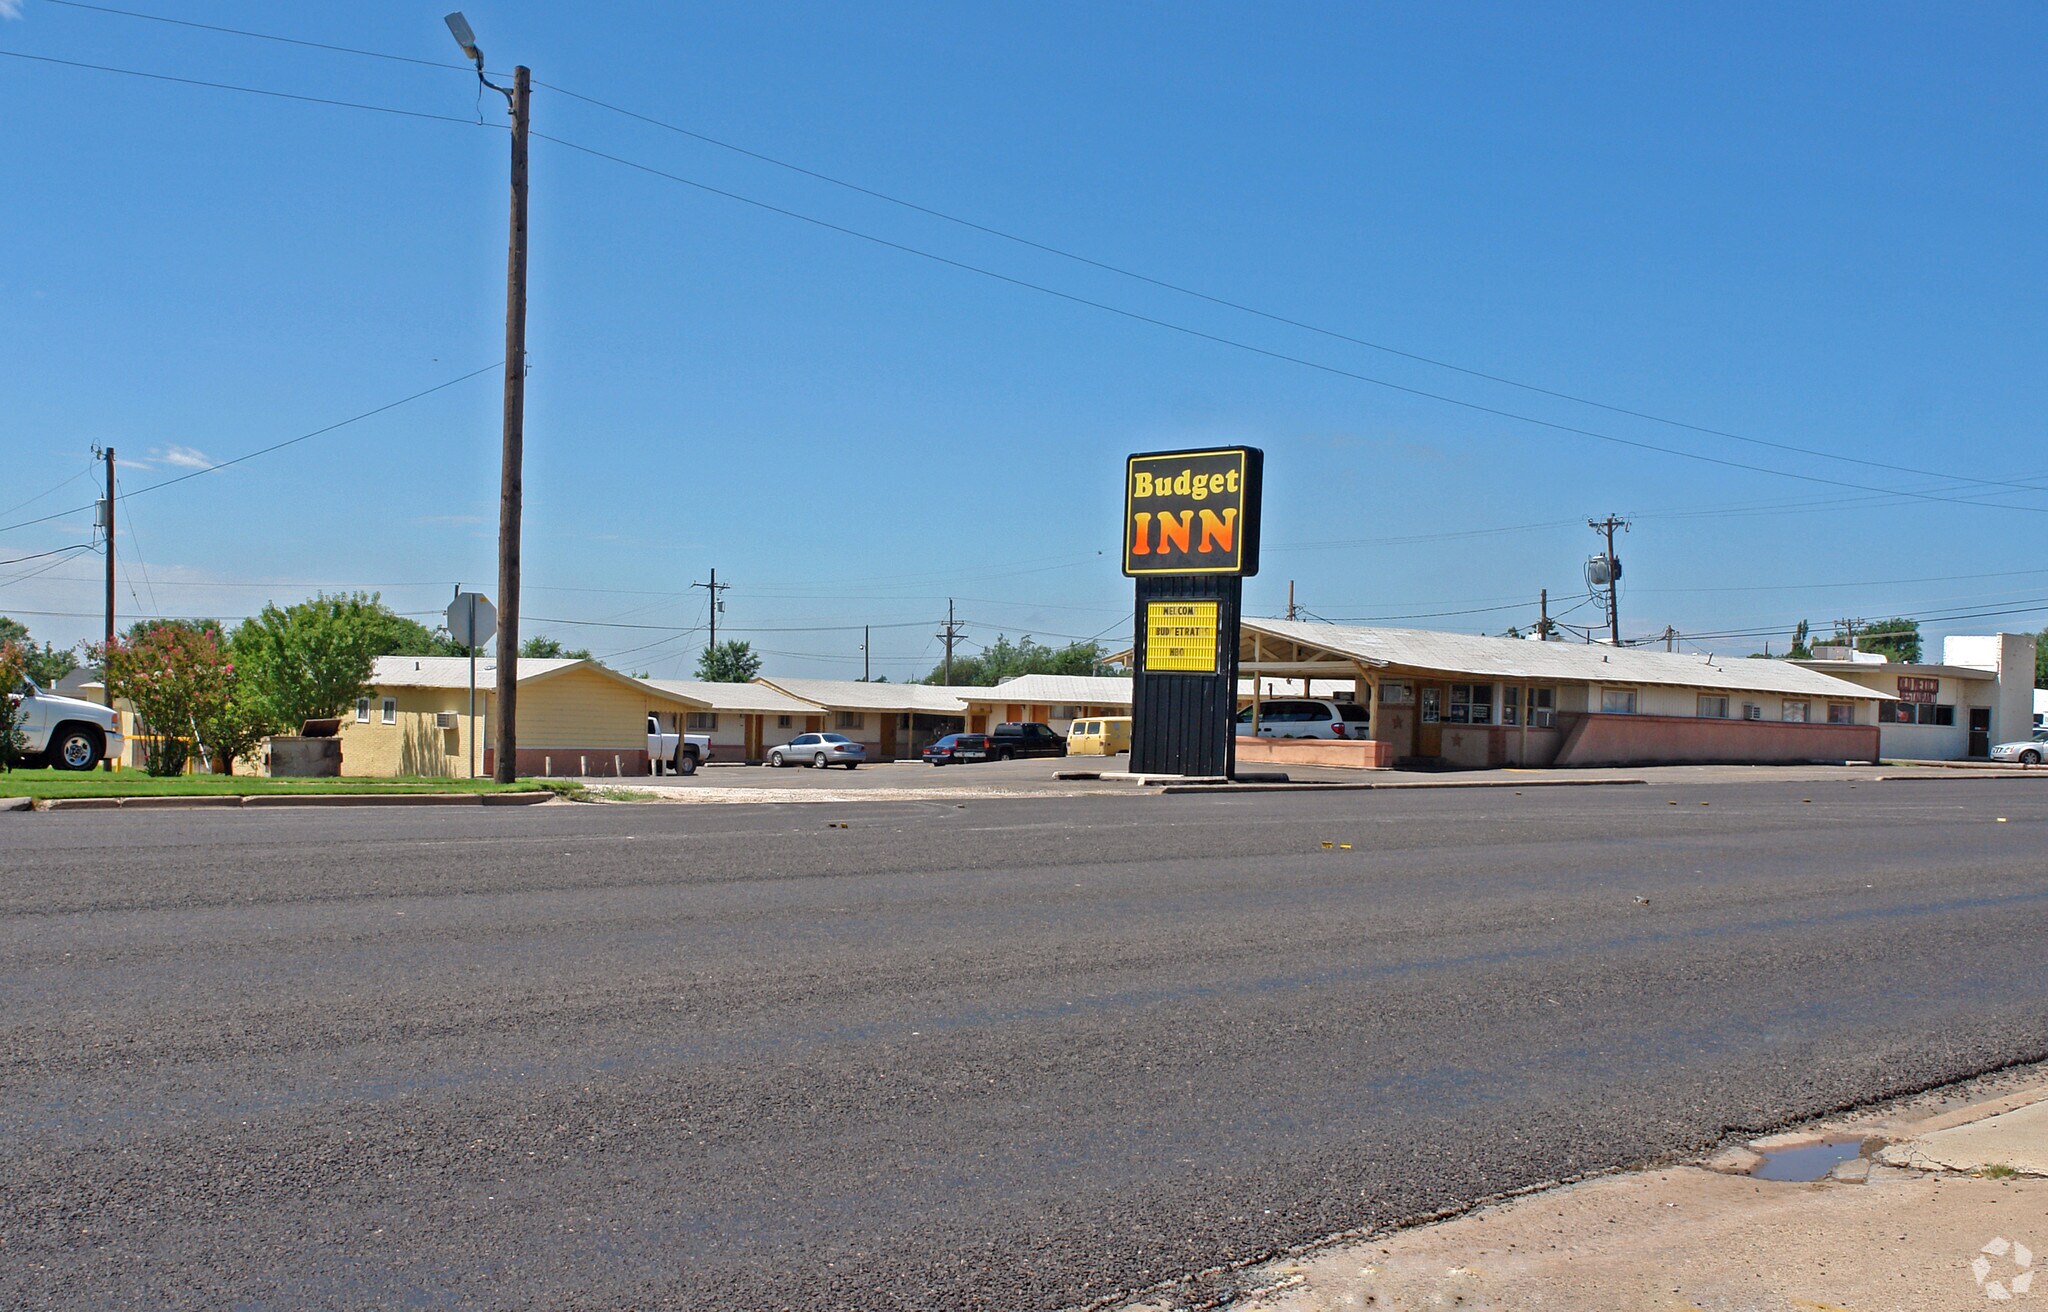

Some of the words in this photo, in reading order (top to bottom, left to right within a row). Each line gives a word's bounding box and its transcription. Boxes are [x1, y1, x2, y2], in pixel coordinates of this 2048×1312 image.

[1133, 468, 1239, 500] Budget
[1131, 507, 1238, 555] INN
[1163, 606, 1198, 615] WELCOM
